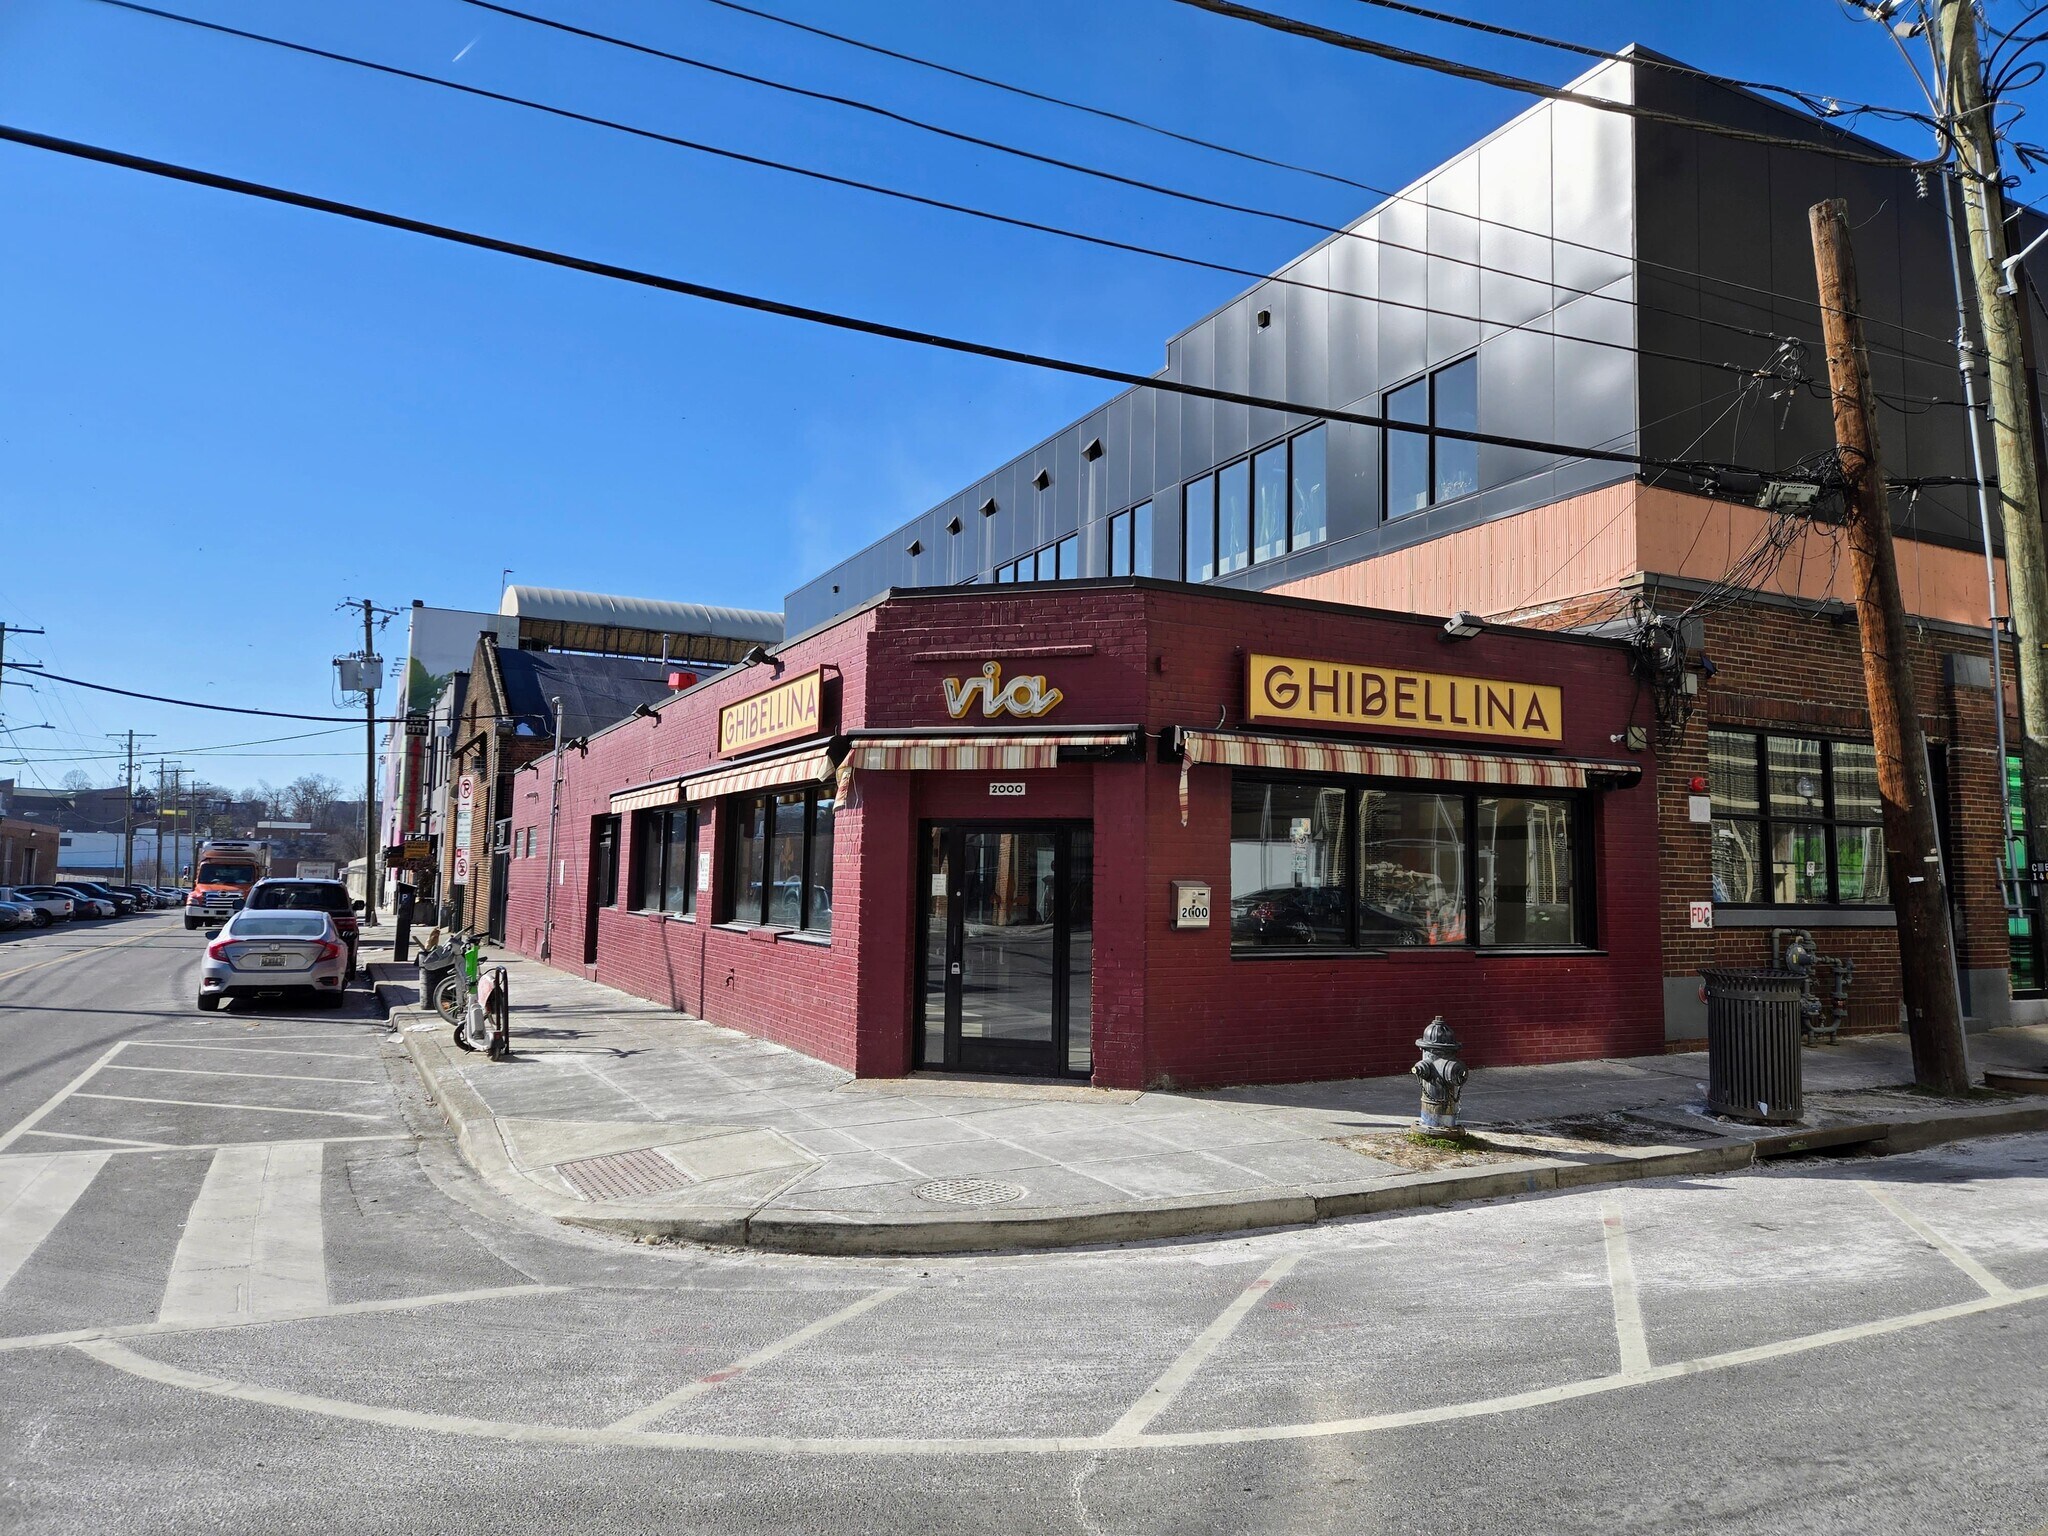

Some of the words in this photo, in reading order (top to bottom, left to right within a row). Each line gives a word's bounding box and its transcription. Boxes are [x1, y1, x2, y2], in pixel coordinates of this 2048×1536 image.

[943, 661, 1062, 719] via
[1263, 665, 1549, 732] GHIBELLINA
[406, 725, 428, 733] CITY
[725, 681, 817, 745] GHIBELLINA
[991, 785, 1023, 793] 2000
[1692, 907, 1710, 923] FDC
